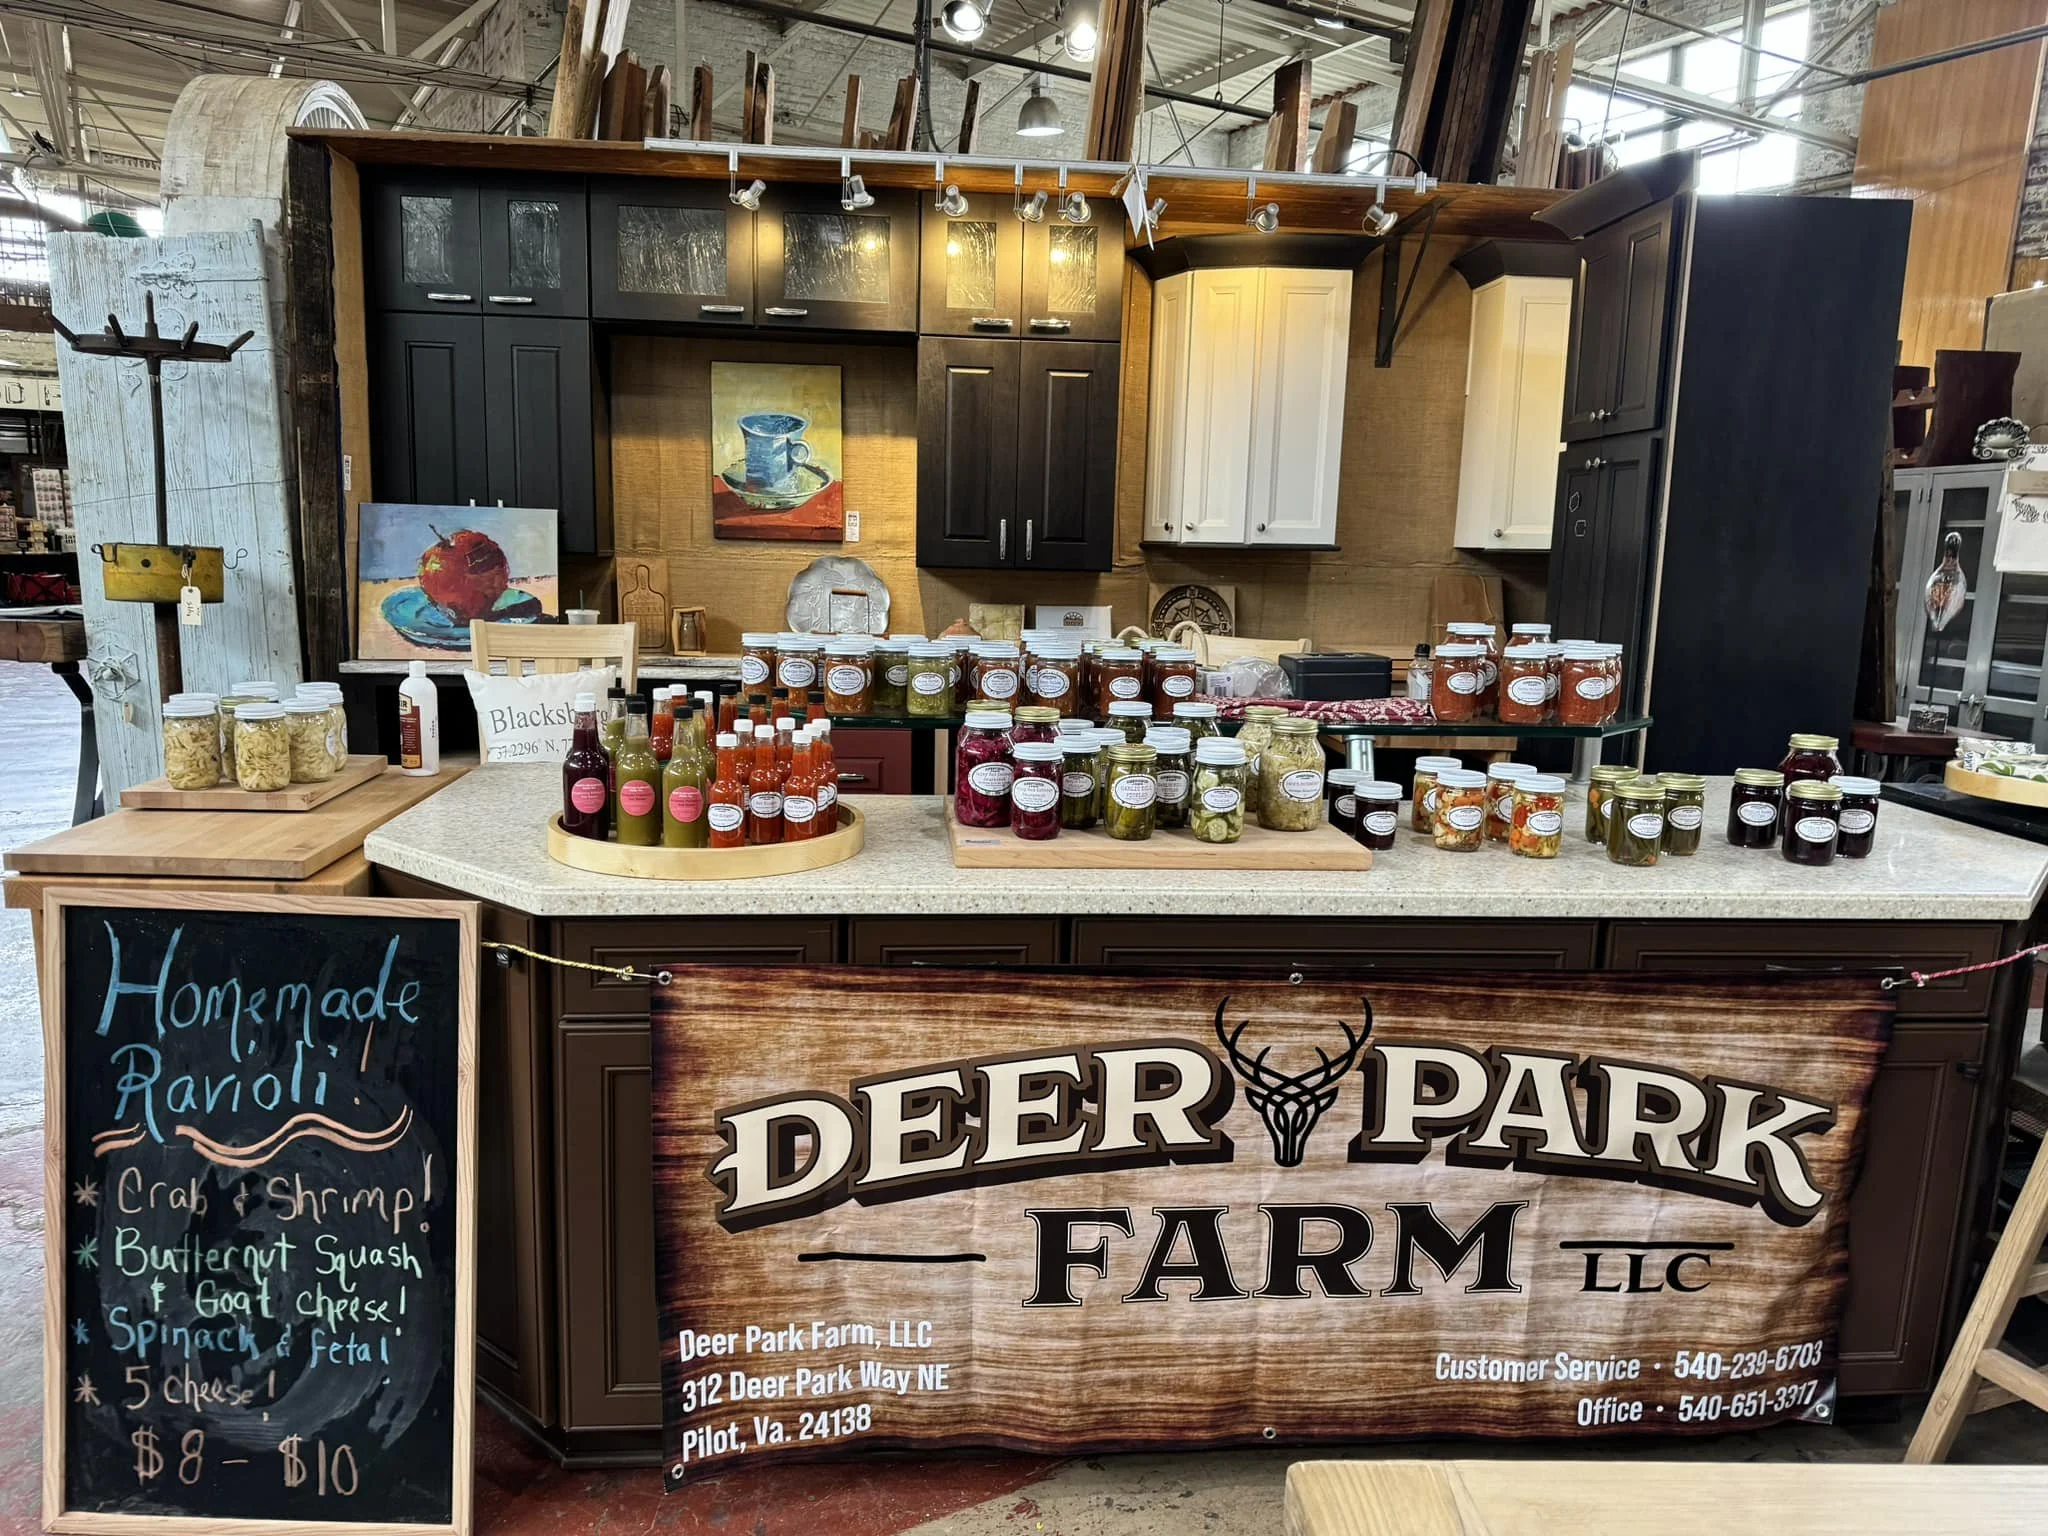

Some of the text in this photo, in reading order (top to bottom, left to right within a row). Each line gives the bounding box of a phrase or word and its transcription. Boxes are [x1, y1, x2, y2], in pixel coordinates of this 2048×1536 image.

[490, 701, 608, 735] Blacksbg
[96, 919, 420, 1063] Homemade
[711, 1045, 1835, 1214] DEER PARK
[118, 1166, 208, 1217] Crab
[266, 1152, 432, 1234] Shrimp!
[115, 1225, 423, 1292] Butternut Squash
[1022, 1200, 1529, 1306] FARM
[1580, 1253, 1712, 1293] LLC
[195, 1276, 275, 1319] Goat
[276, 1322, 291, 1357] &
[680, 1320, 933, 1362] Deer Park Farm, LLC
[1435, 1339, 1824, 1383] Customer Service 540-239-6703
[125, 1364, 151, 1410] 5
[682, 1360, 950, 1413] 312 Deer Park Way NE
[1577, 1379, 1819, 1426] Office 540-651-3317
[682, 1403, 872, 1463] Pilot, Va. 24138
[278, 1433, 359, 1496] $10
